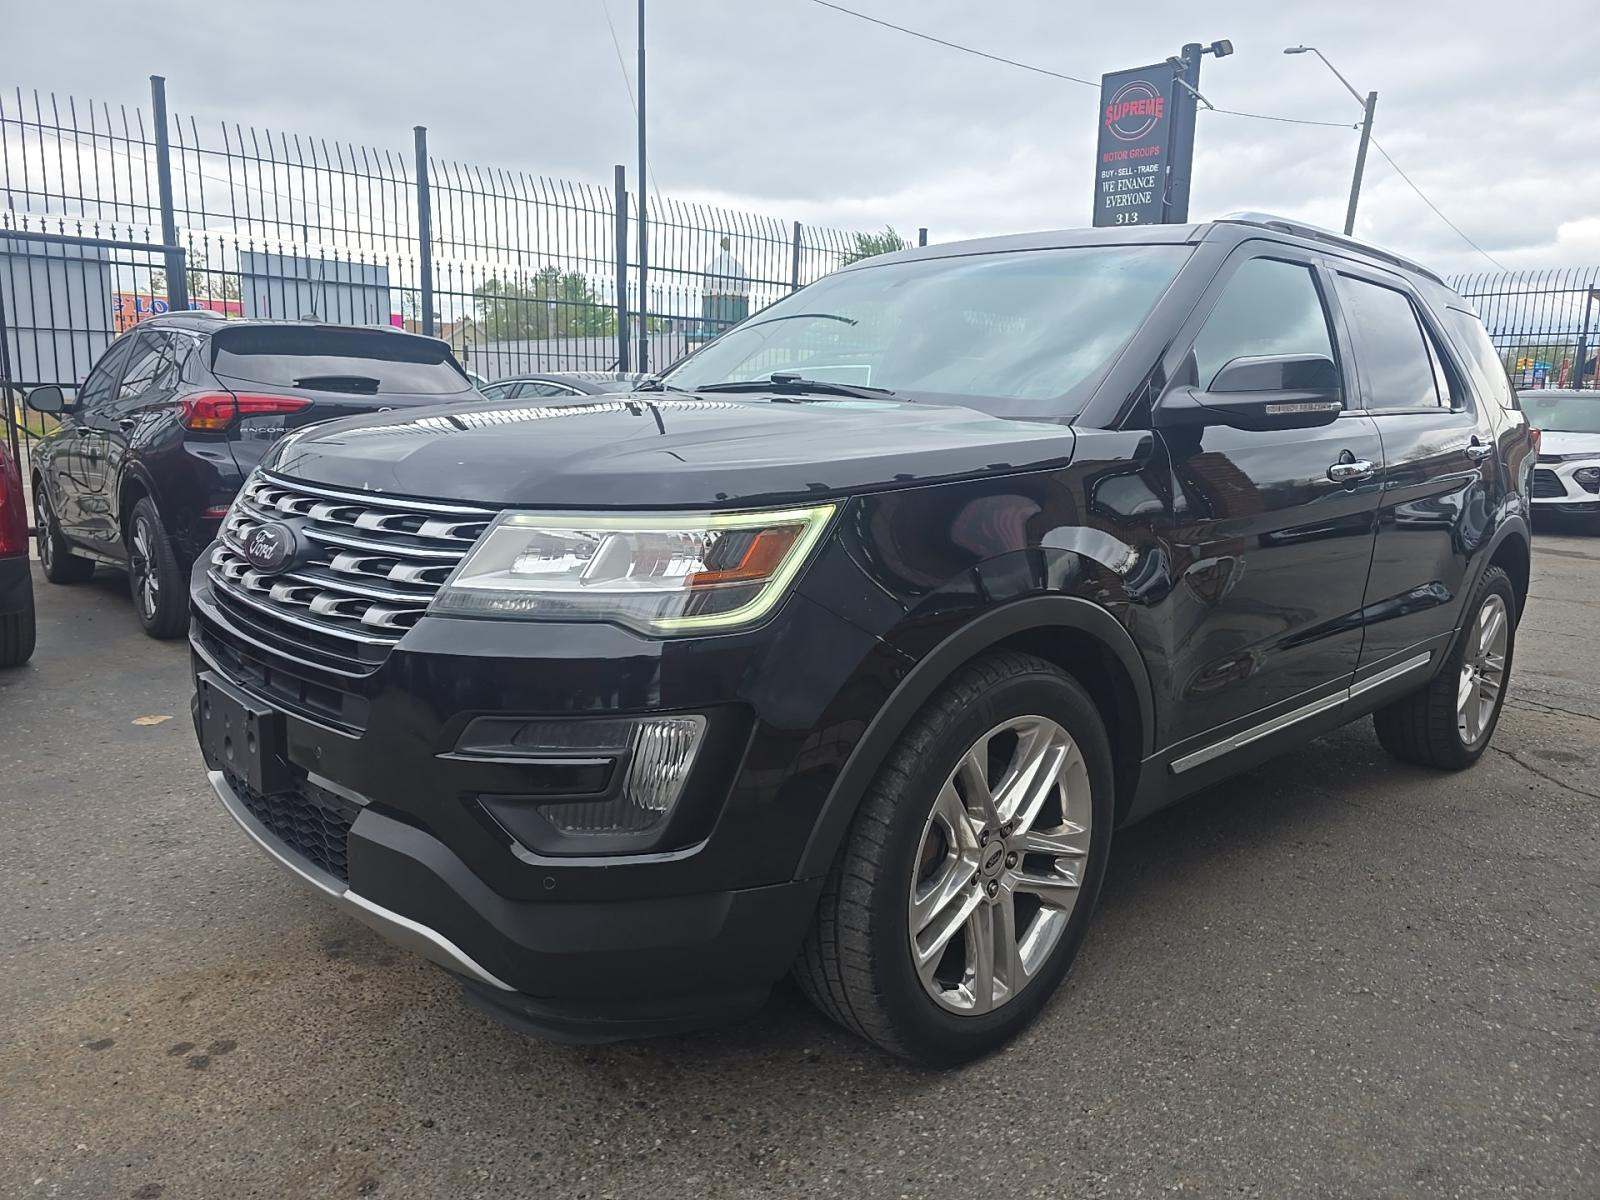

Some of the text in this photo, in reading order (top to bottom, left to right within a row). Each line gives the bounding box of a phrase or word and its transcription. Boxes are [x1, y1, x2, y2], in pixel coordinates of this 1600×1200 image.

[1105, 96, 1164, 127] SUPREME
[1103, 145, 1160, 162] MOTOR GROUPS
[1101, 169, 1114, 178] BUY
[1118, 167, 1132, 176] SELL
[1138, 164, 1159, 174] TRADE
[1102, 176, 1155, 192] WE FINANCE
[1105, 191, 1152, 208] EVERYONE
[1116, 212, 1138, 224] 313
[249, 529, 279, 560] Ford
